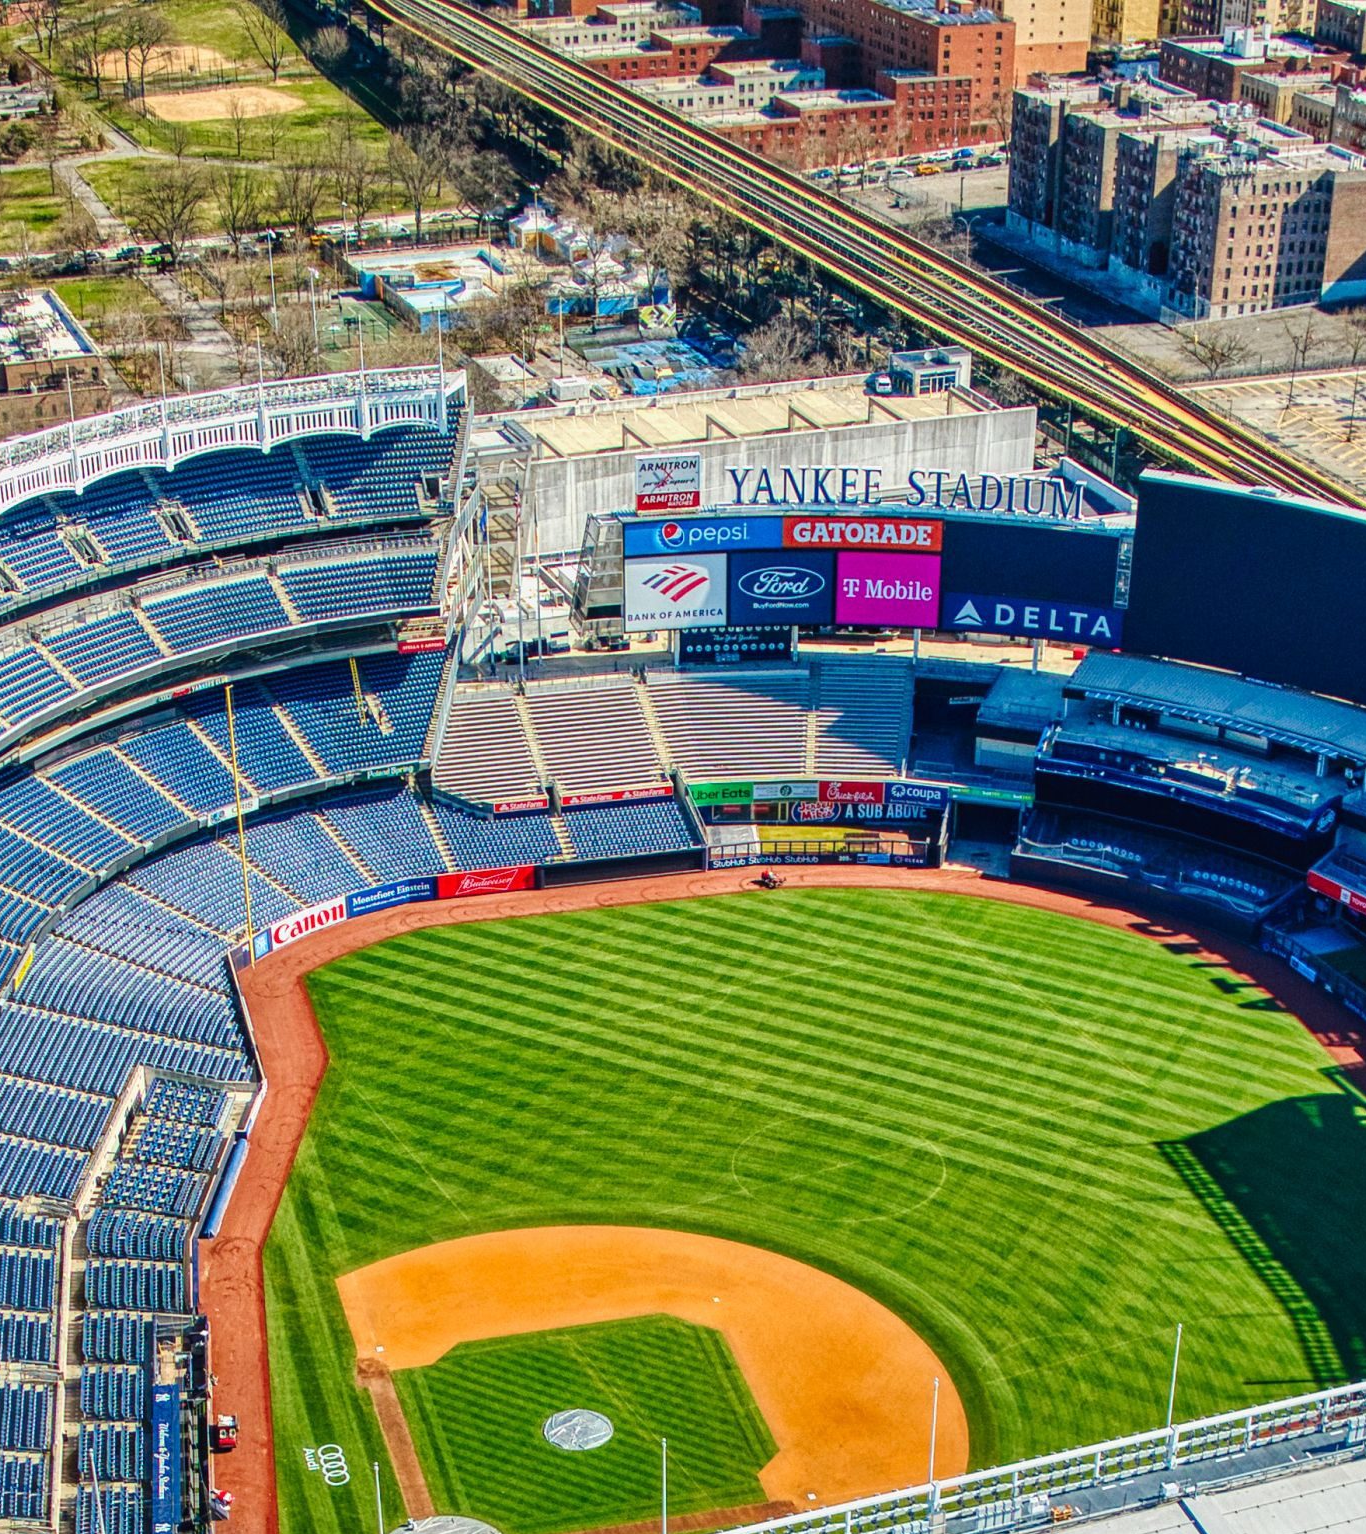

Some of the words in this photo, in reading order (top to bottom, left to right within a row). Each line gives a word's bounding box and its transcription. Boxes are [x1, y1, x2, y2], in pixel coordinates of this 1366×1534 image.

[639, 459, 697, 473] ARMITRON
[642, 493, 694, 505] ARMITRON
[725, 465, 883, 506] YANKEE
[906, 467, 1088, 521] STADIUM
[688, 522, 748, 545] pepsi
[793, 523, 932, 546] GATORADE
[753, 570, 809, 594] Ford
[864, 579, 933, 601] Mobile
[627, 611, 657, 622] BANK
[659, 611, 673, 620] OF
[675, 608, 724, 618] AMERICA
[995, 603, 1112, 638] DELTA
[722, 788, 751, 799] Eats
[906, 787, 941, 801] coupa
[845, 805, 854, 818] A
[857, 804, 883, 818] SUB
[886, 803, 927, 818] ABOVE
[713, 858, 746, 868] StubHub
[784, 855, 819, 864] StubHub
[462, 875, 512, 889] Budweiser
[352, 889, 396, 906] Montefiore
[396, 883, 430, 895] Einstein
[273, 903, 345, 945] Canon
[303, 1448, 320, 1471] Audi
